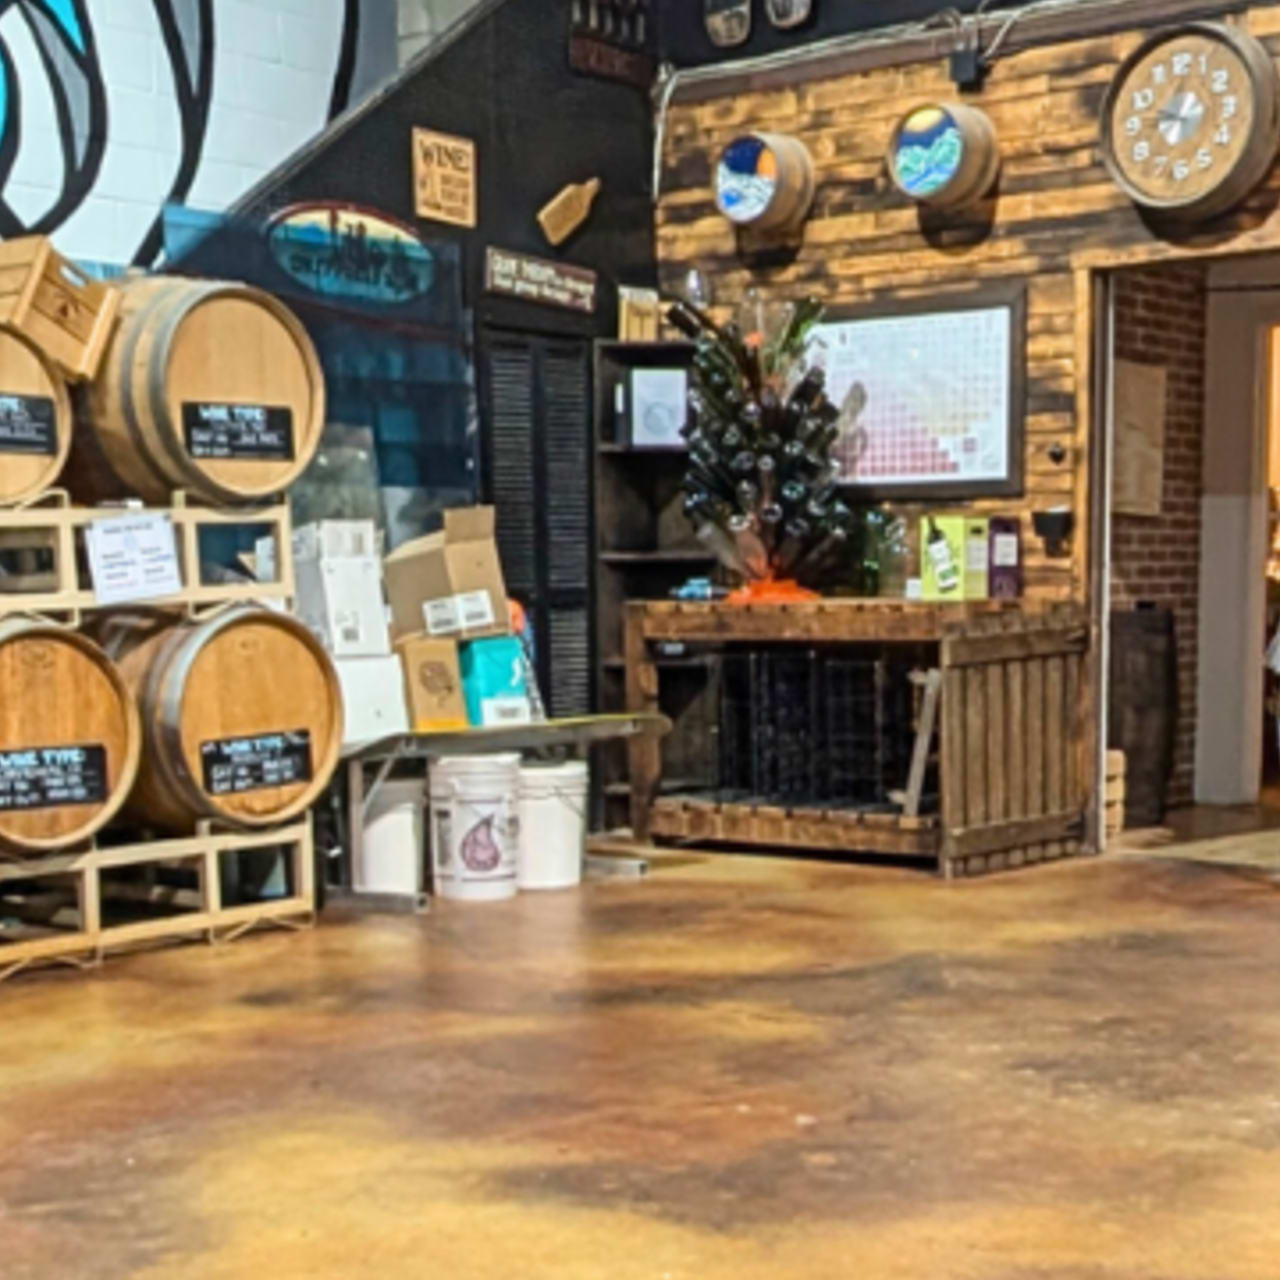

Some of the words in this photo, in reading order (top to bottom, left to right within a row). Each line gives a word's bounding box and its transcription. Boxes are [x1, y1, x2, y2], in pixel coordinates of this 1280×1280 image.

[1172, 52, 1193, 76] 12
[1198, 52, 1208, 75] 1
[1211, 69, 1228, 93] 2
[1132, 88, 1154, 110] 10
[1222, 95, 1237, 118] 3
[1126, 116, 1141, 136] 9
[1213, 123, 1230, 144] 4
[1132, 140, 1149, 161] 8
[1196, 147, 1213, 169] 5
[1154, 155, 1168, 175] 7
[1173, 159, 1189, 180] 6
